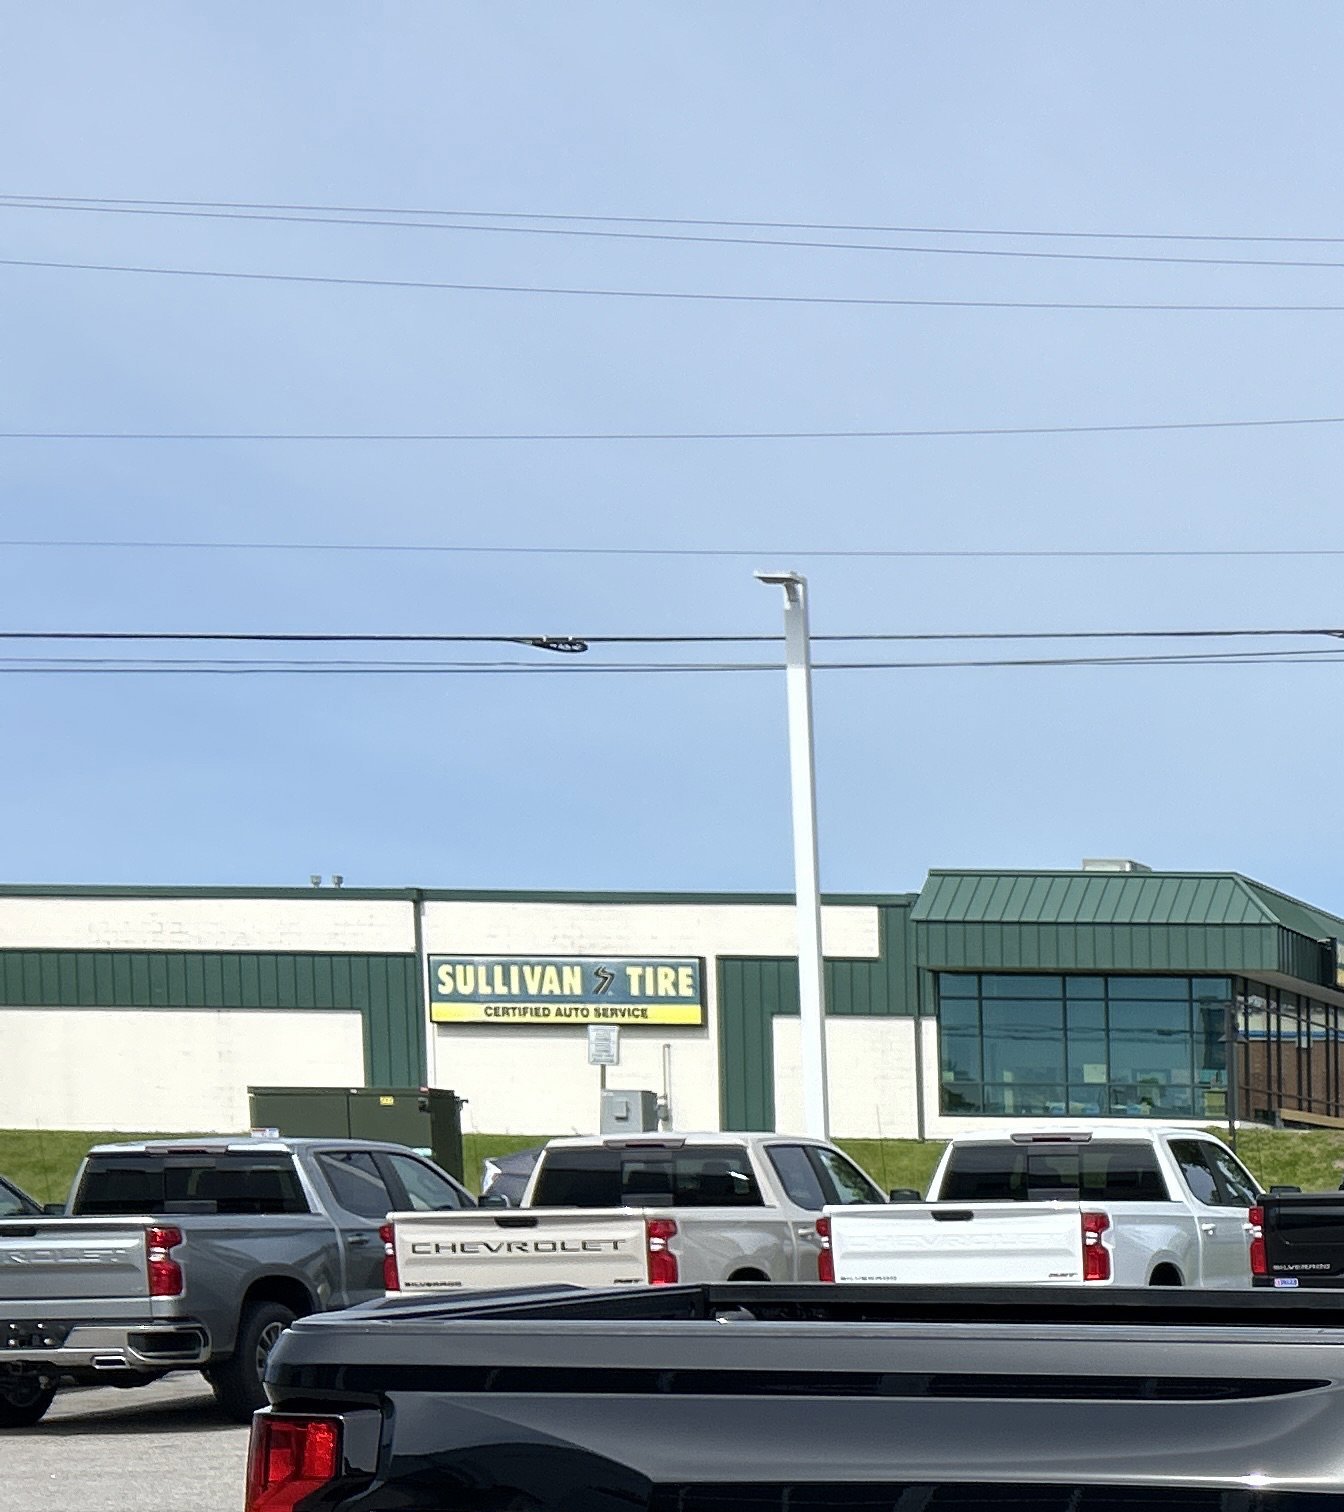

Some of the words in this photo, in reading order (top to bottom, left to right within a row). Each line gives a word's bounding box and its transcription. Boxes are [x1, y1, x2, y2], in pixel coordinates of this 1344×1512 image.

[437, 963, 583, 996] SULLIVAN
[625, 966, 695, 998] TIRE
[484, 1006, 551, 1017] CERTIFIED
[555, 1007, 589, 1018] AUTO
[594, 1007, 649, 1018] SERVICE
[411, 1239, 626, 1255] CHEVROLET
